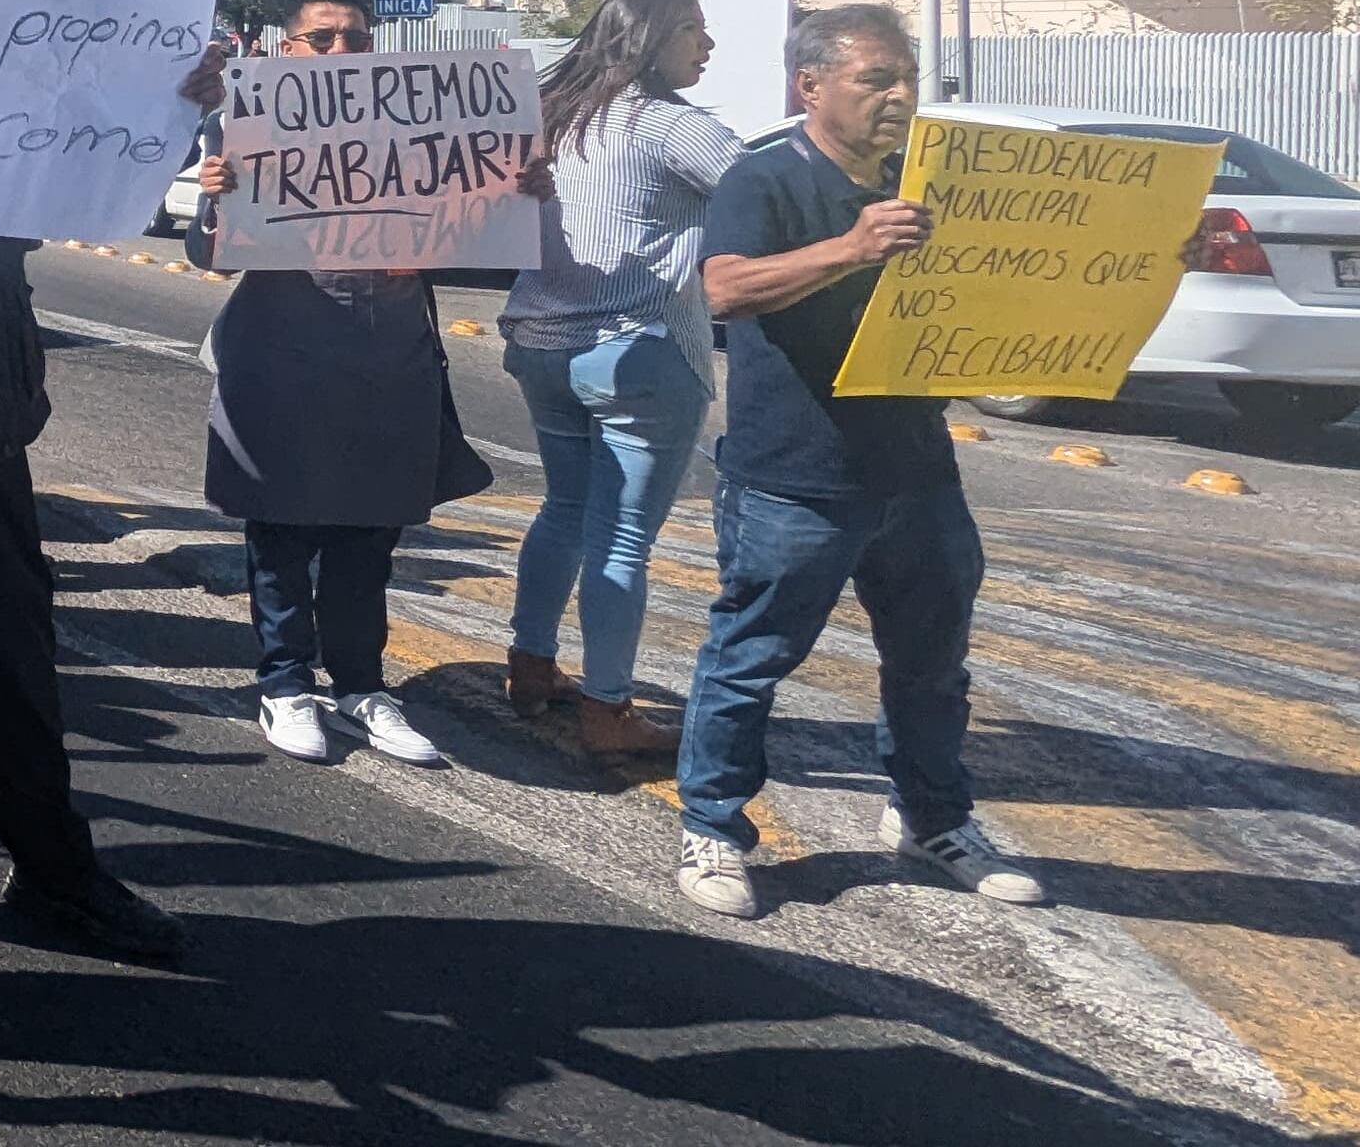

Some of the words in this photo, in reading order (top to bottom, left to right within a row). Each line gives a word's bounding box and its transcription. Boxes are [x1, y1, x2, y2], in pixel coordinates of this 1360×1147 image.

[917, 122, 1159, 187] PRESIDENCIA
[922, 181, 1093, 227] MUNICIPAL
[897, 244, 1068, 281] BUSCAMOS
[1083, 251, 1159, 285] QUE
[889, 287, 956, 320] NOS
